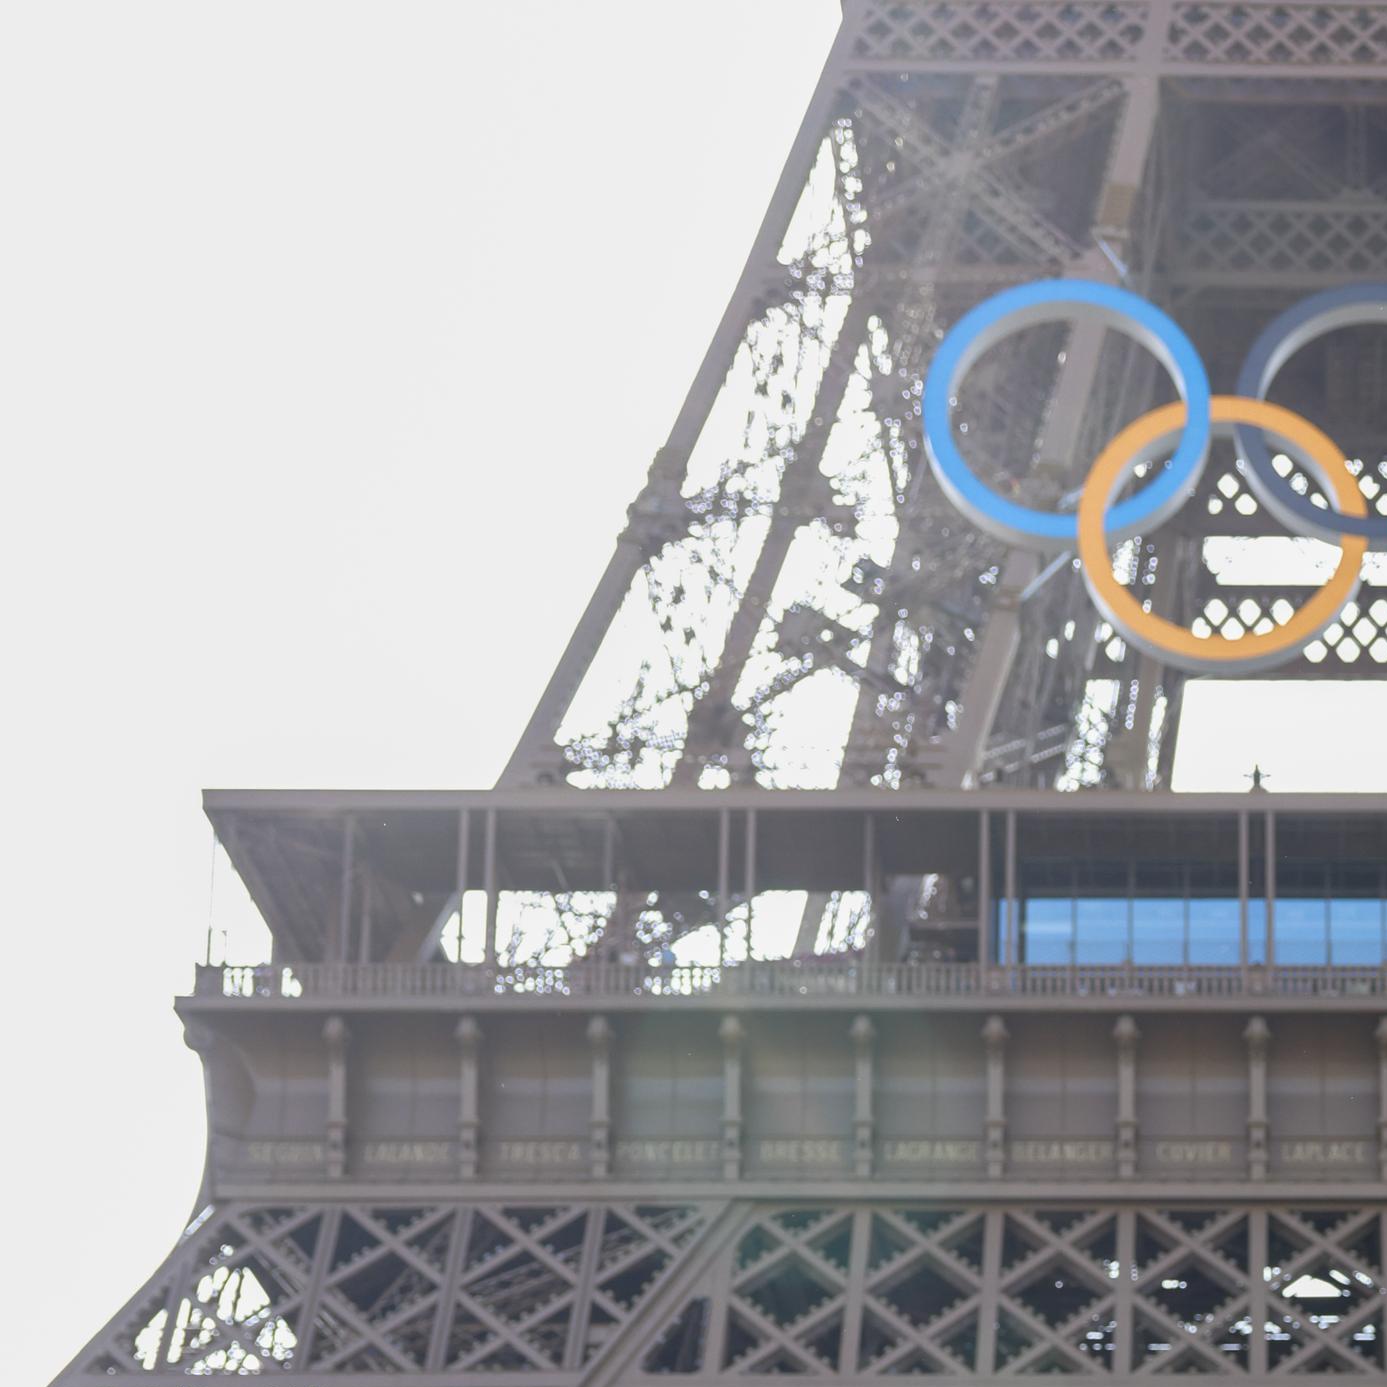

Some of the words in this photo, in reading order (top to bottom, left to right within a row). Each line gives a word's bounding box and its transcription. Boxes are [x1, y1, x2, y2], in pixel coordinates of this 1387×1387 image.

[499, 1141, 581, 1162] TRESCA
[883, 1141, 979, 1162] LAGRANGE
[1155, 1141, 1231, 1162] CUVIER
[1280, 1141, 1366, 1162] LAPLACE
